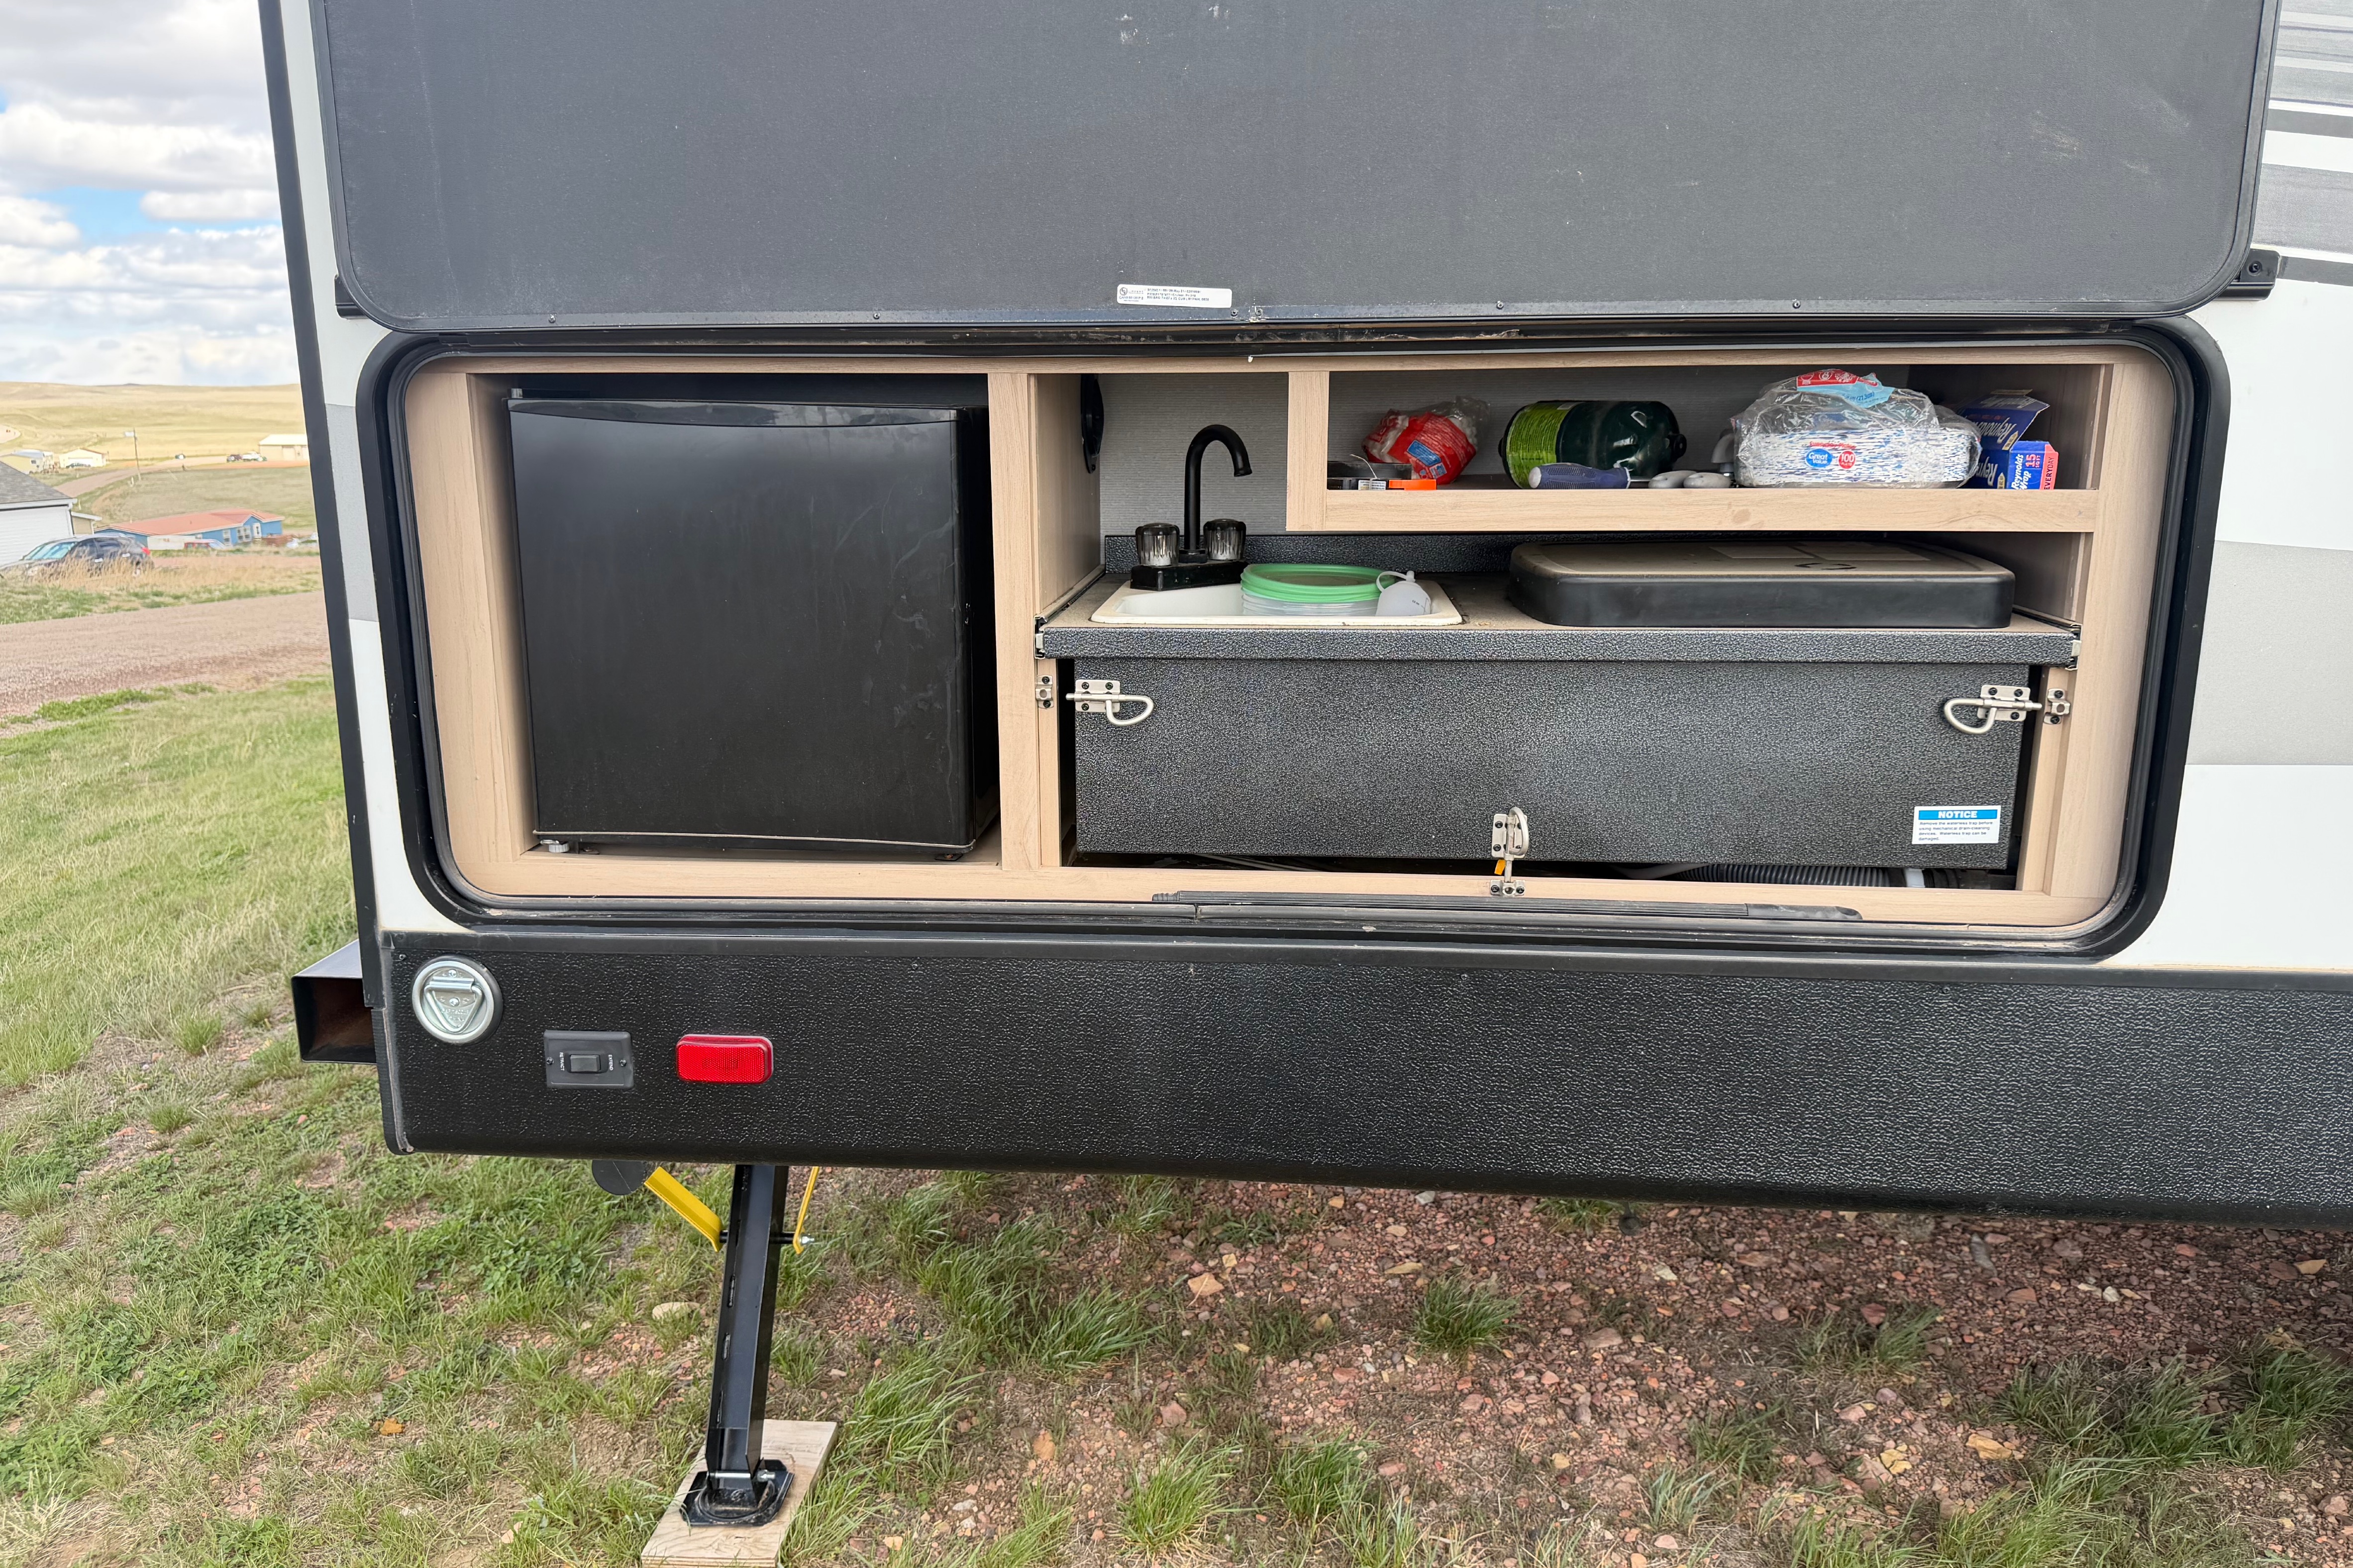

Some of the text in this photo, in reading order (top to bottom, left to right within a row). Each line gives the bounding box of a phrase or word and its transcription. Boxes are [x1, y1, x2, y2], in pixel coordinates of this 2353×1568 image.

[1841, 453, 1854, 463] 100
[2025, 454, 2037, 468] 15
[2011, 453, 2024, 490] Reynolds
[2044, 457, 2054, 490] EVERYDAY
[2020, 471, 2032, 490] Wrap
[1938, 810, 1978, 819] NOTICE
